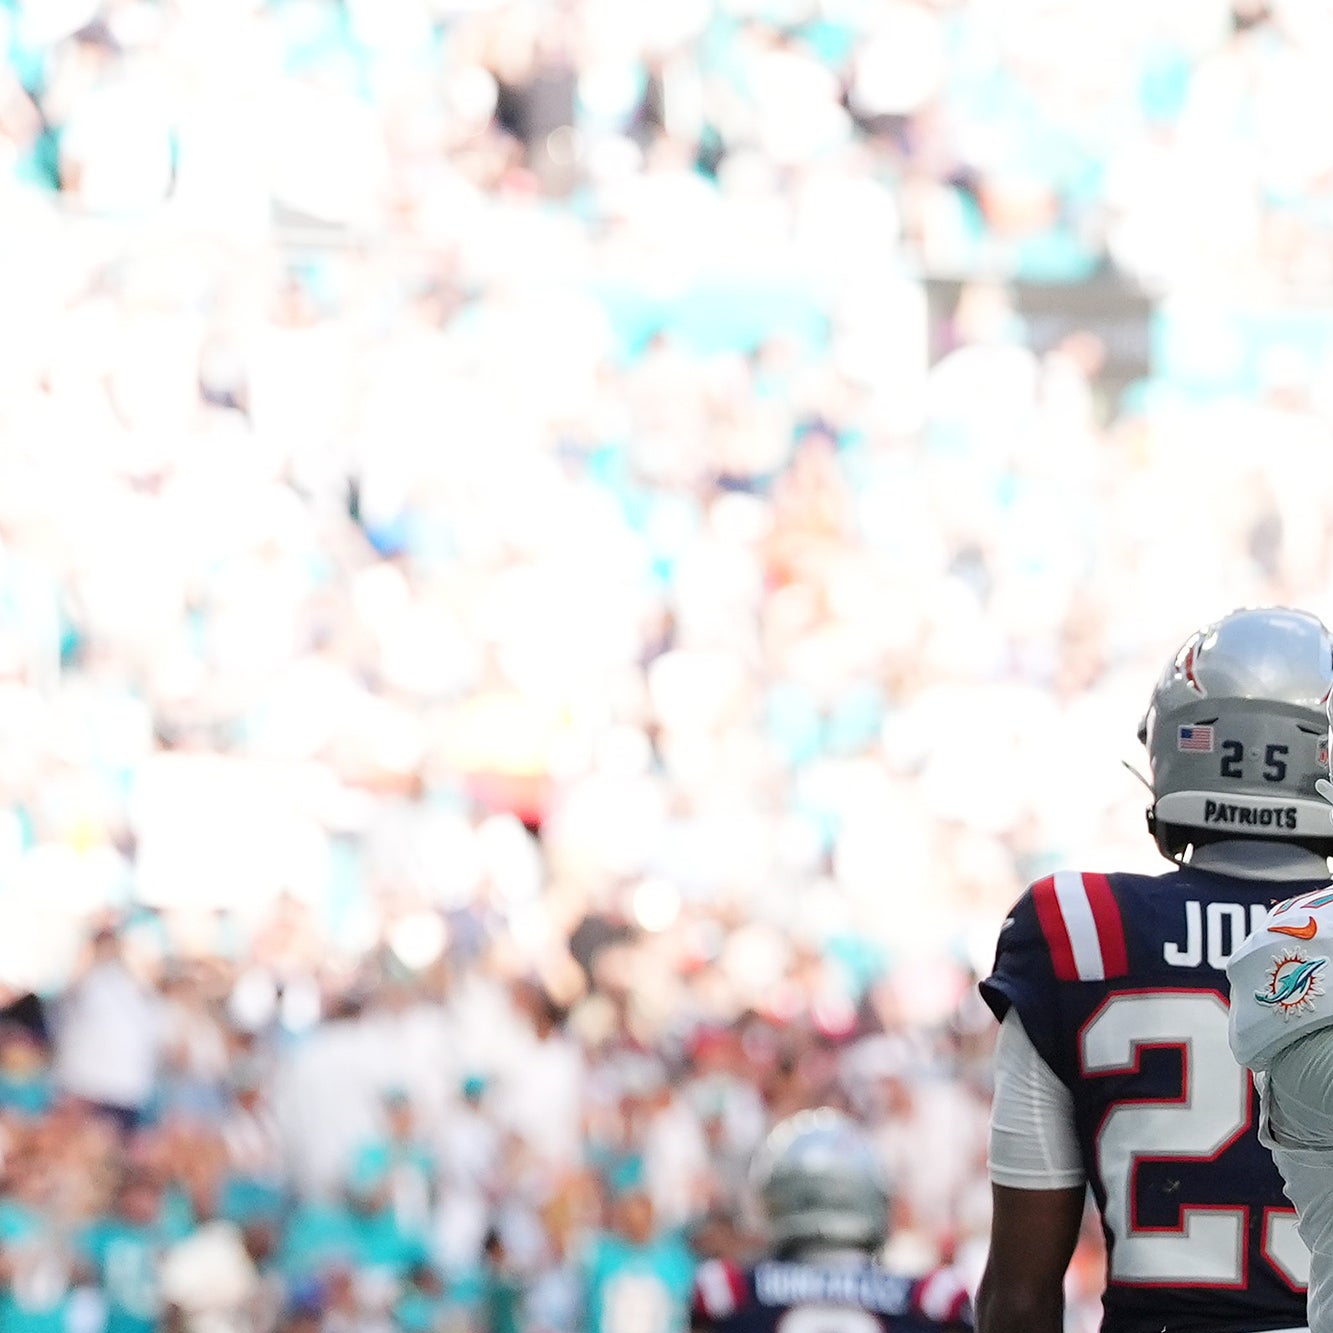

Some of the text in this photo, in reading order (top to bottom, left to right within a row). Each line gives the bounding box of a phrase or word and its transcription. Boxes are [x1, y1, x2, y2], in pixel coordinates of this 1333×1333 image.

[1220, 740, 1288, 782] 25
[1204, 799, 1297, 829] PATRIOTS
[1077, 985, 1308, 1293] 2
